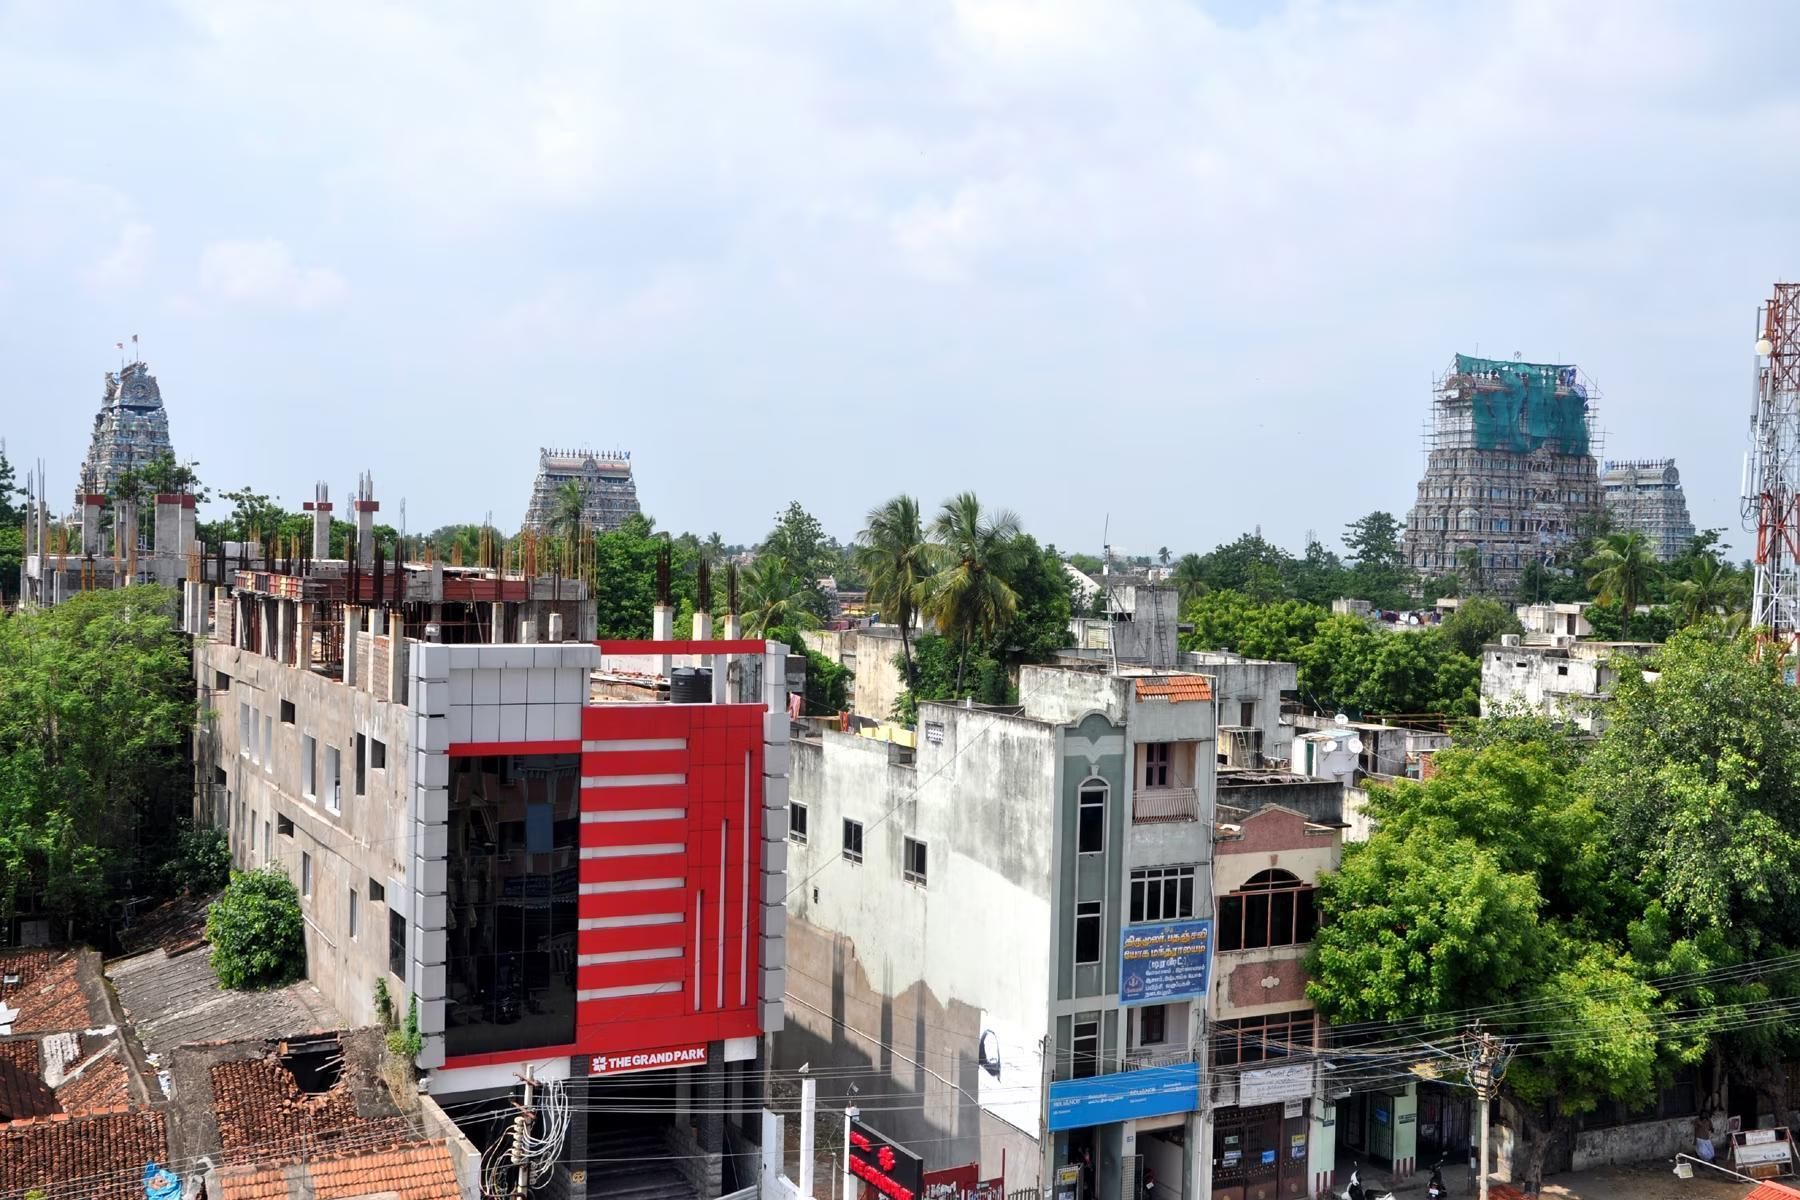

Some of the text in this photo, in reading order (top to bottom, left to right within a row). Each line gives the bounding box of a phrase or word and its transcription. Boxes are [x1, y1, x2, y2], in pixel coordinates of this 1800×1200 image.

[609, 1048, 705, 1069] THE GRAND PARK
